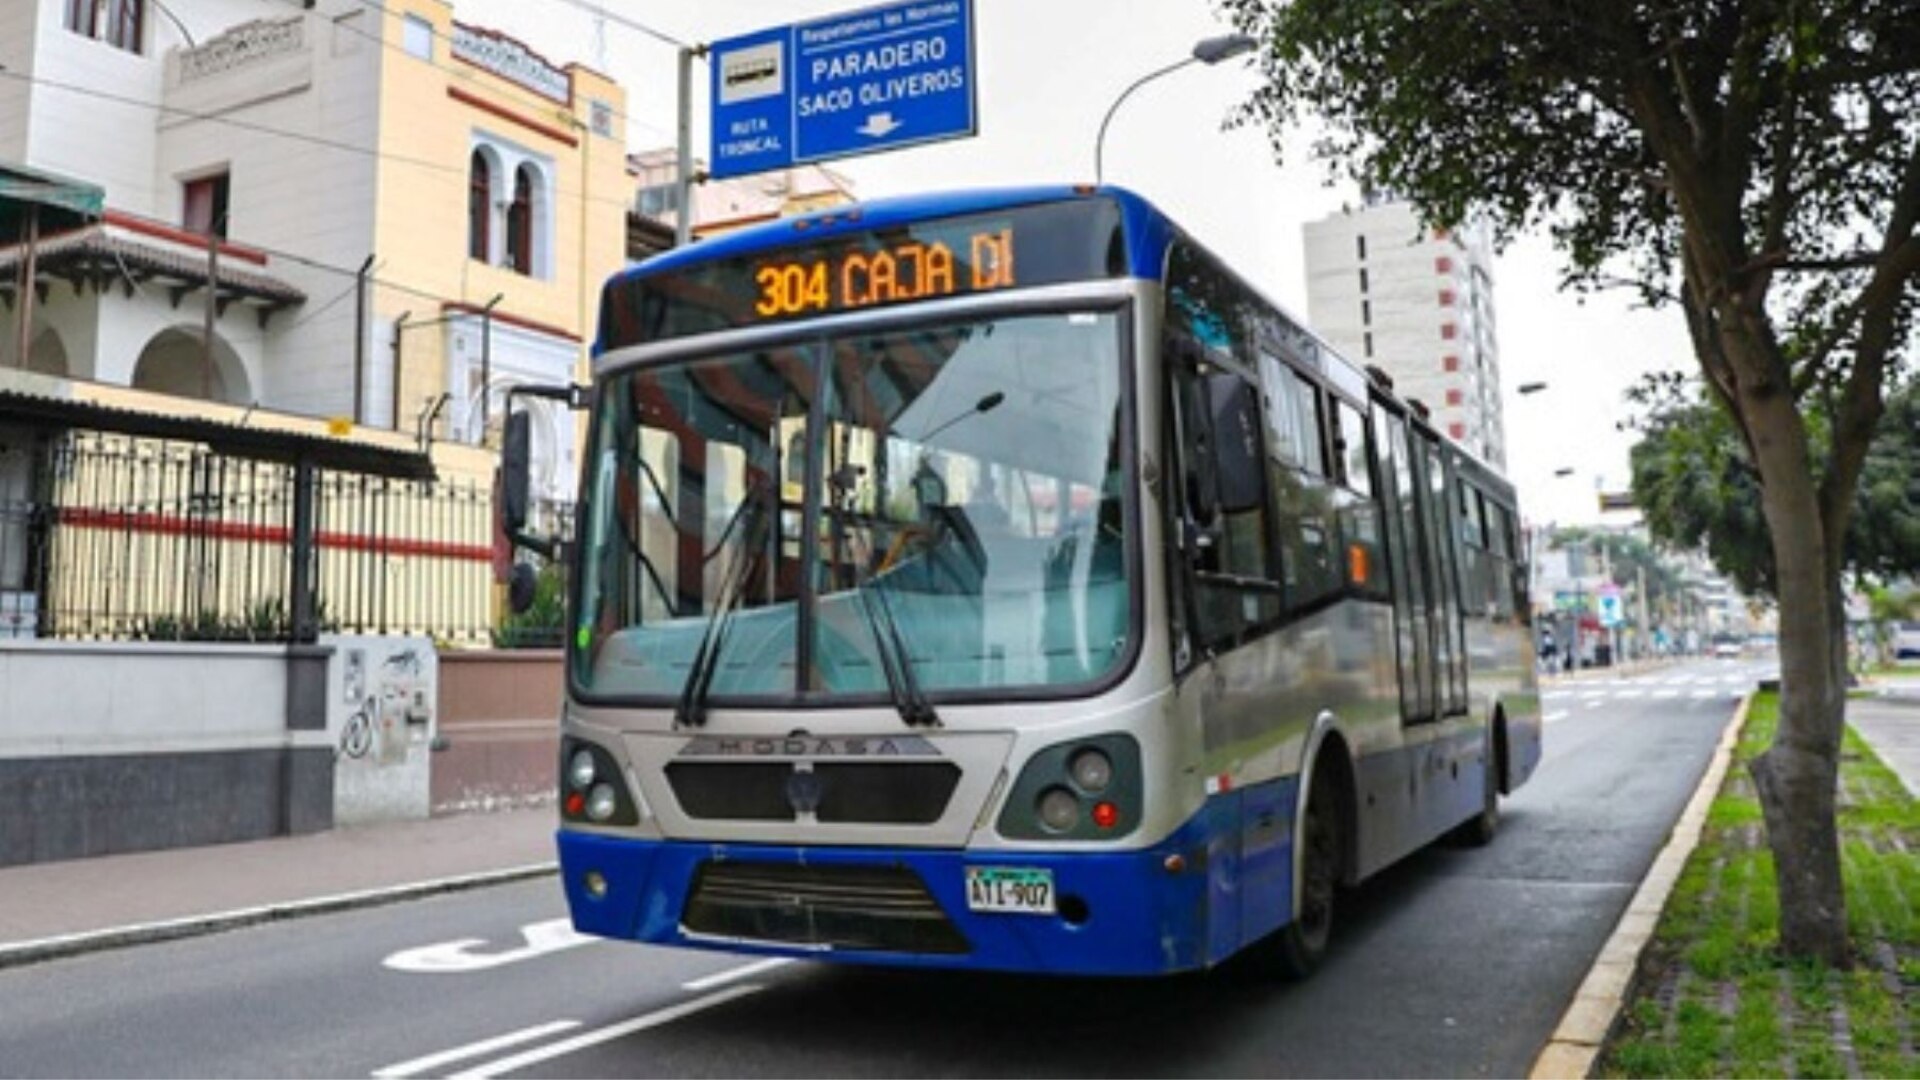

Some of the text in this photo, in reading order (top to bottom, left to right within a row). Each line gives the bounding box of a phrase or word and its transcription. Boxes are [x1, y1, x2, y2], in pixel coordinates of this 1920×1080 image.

[811, 36, 946, 84] PARADERO
[798, 66, 964, 117] SACO OLIVEROS
[731, 118, 768, 134] RUTA
[720, 136, 781, 158] TRONCAL
[755, 260, 829, 317] 304
[841, 240, 954, 308] CAJA
[719, 737, 899, 755] MODASA
